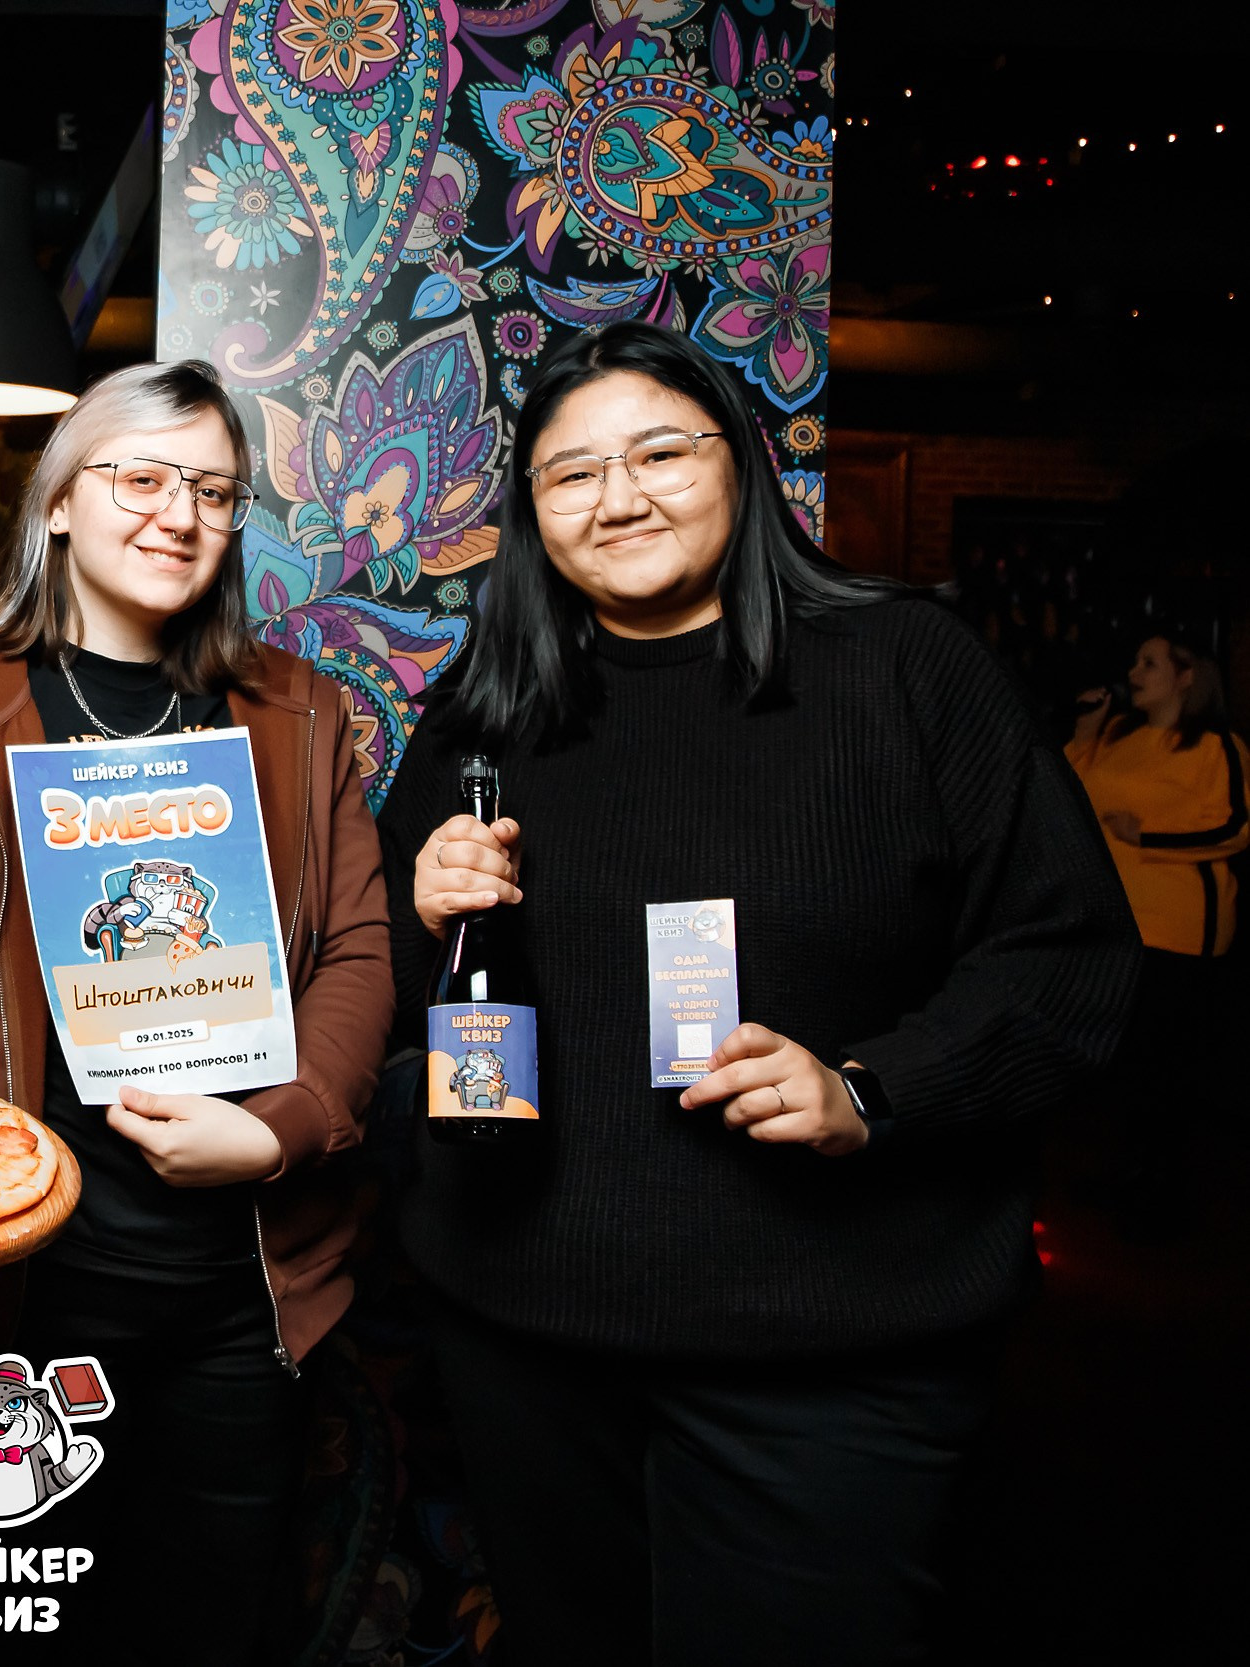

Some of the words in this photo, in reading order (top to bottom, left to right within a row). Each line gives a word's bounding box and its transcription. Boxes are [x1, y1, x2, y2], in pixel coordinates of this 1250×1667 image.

[72, 762, 138, 782] ШЕЙКЕР
[143, 760, 188, 778] КВИЗ
[46, 794, 82, 844] 3
[88, 790, 229, 843] МЕСТО
[650, 915, 690, 926] ШЕЙКЕР
[657, 928, 684, 937] КВИЗ
[673, 954, 709, 966] ОДНА
[654, 968, 730, 981] БЕСПЛАТНАЯ
[676, 983, 708, 995] ИГРА
[668, 1001, 681, 1010] НА
[683, 999, 720, 1010] ОДНОГО
[451, 1010, 511, 1029] ШЕЙКЕР
[671, 1011, 718, 1021] ЧЕЛОВЕКА
[136, 1028, 194, 1044] 09.01.2025
[461, 1029, 503, 1043] КВИЗ
[86, 1066, 156, 1079] КИНОМАРАФОН
[159, 1062, 182, 1074] [100
[186, 1053, 249, 1070] ВОПРОСОВ]
[253, 1051, 268, 1061] #1
